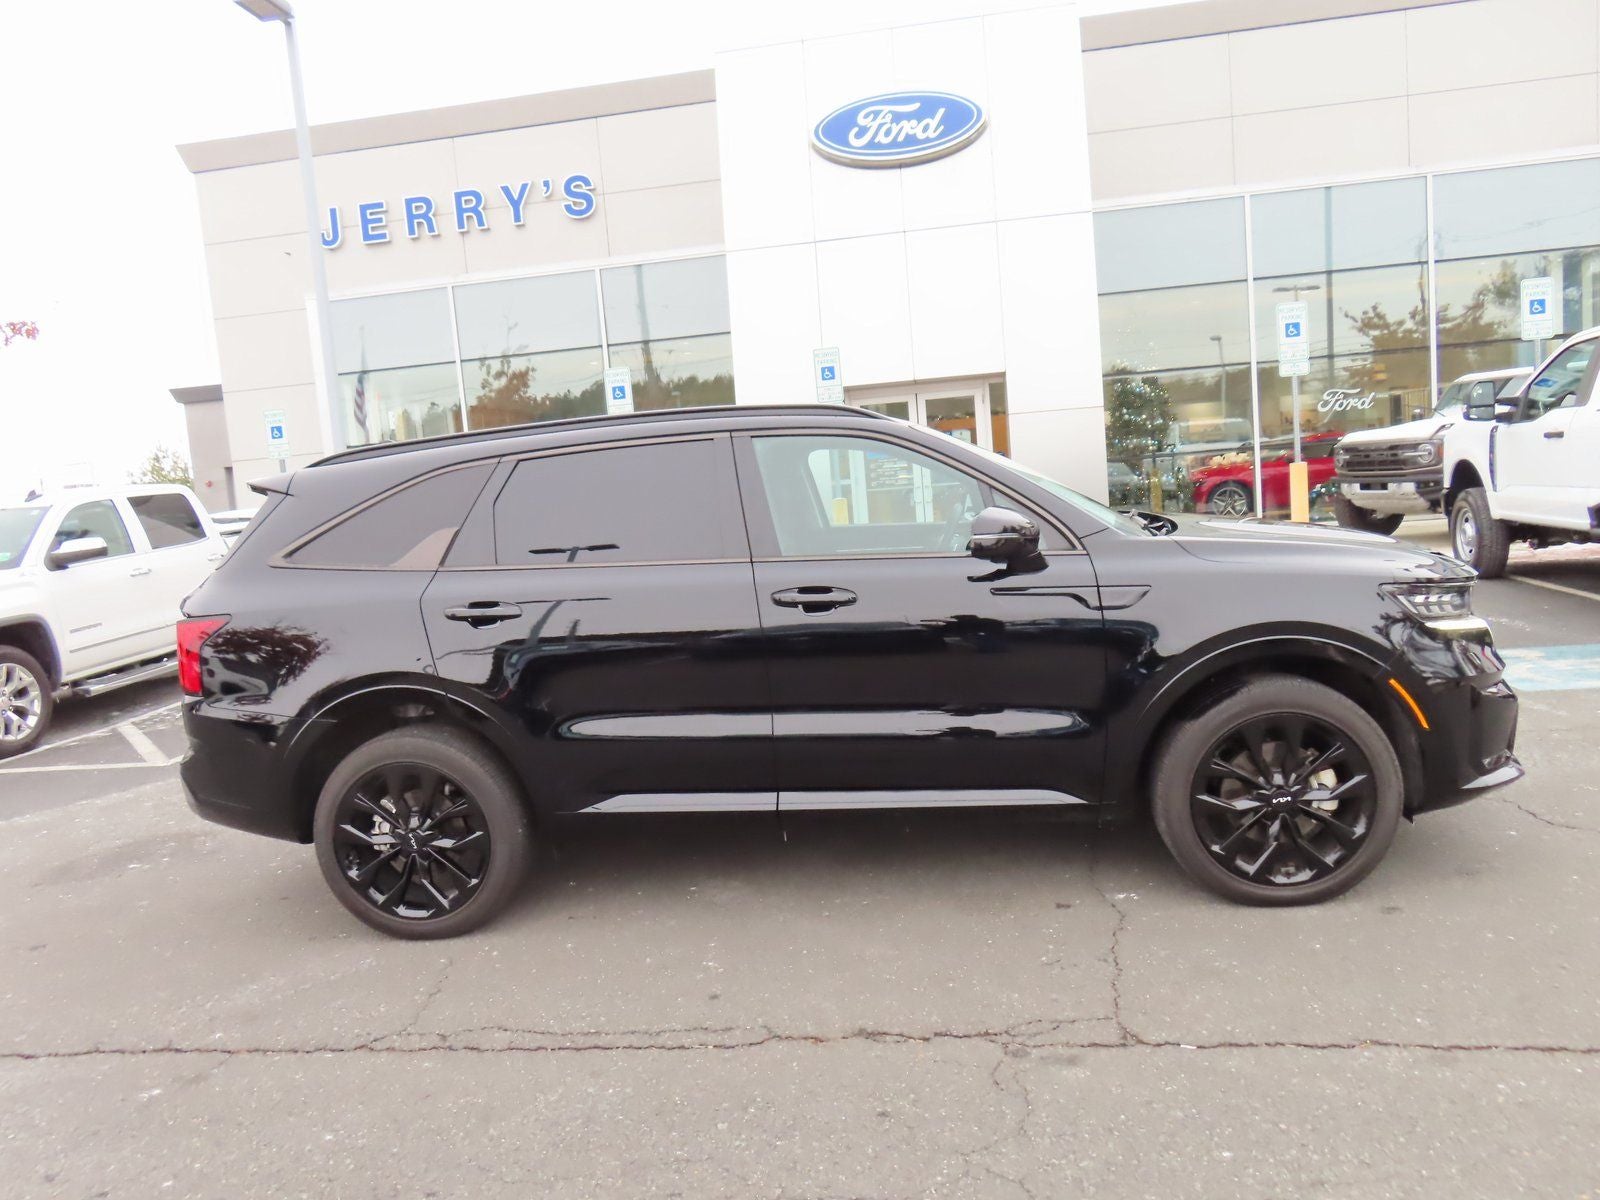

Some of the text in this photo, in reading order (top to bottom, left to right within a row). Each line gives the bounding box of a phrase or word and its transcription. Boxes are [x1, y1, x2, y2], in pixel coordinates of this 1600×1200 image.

[849, 102, 946, 147] Ford
[320, 173, 596, 249] JERRY'S
[1318, 388, 1376, 412] Ford
